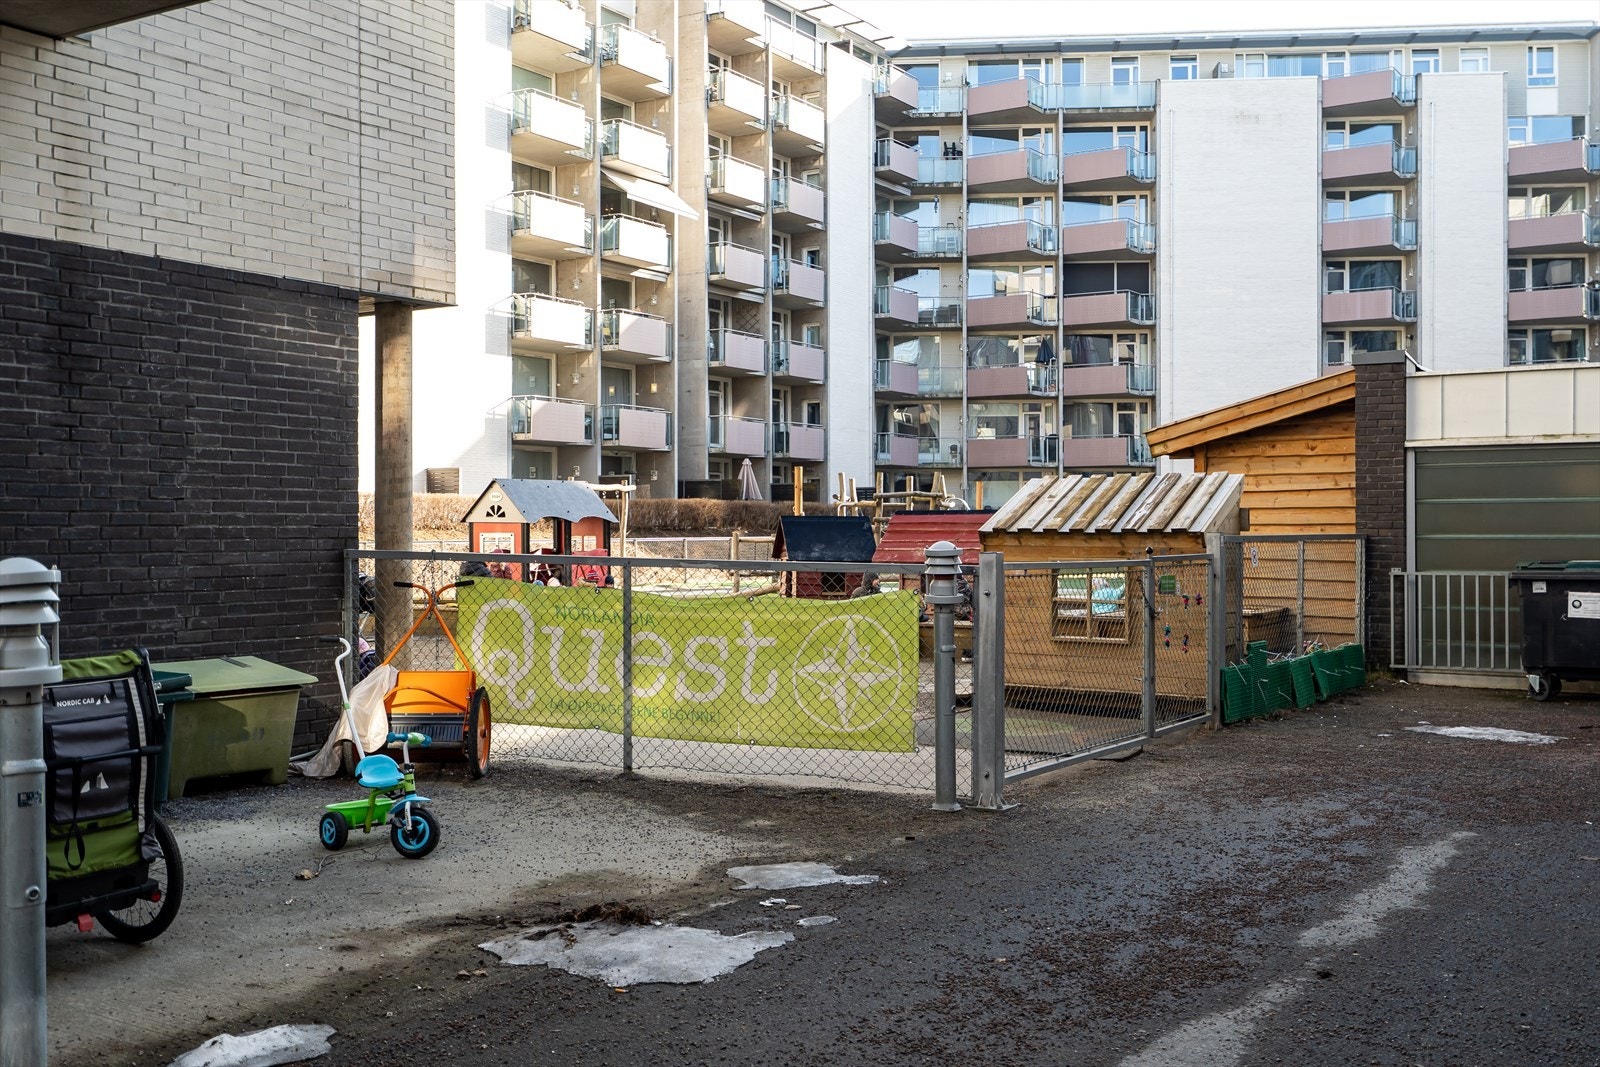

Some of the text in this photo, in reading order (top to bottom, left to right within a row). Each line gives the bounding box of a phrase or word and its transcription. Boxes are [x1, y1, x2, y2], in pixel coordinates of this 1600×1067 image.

[554, 604, 656, 627] NORLANDIA
[471, 599, 778, 710] Quest
[56, 697, 95, 707] NORDIC CAB
[568, 699, 658, 719] OPPDAGESENE
